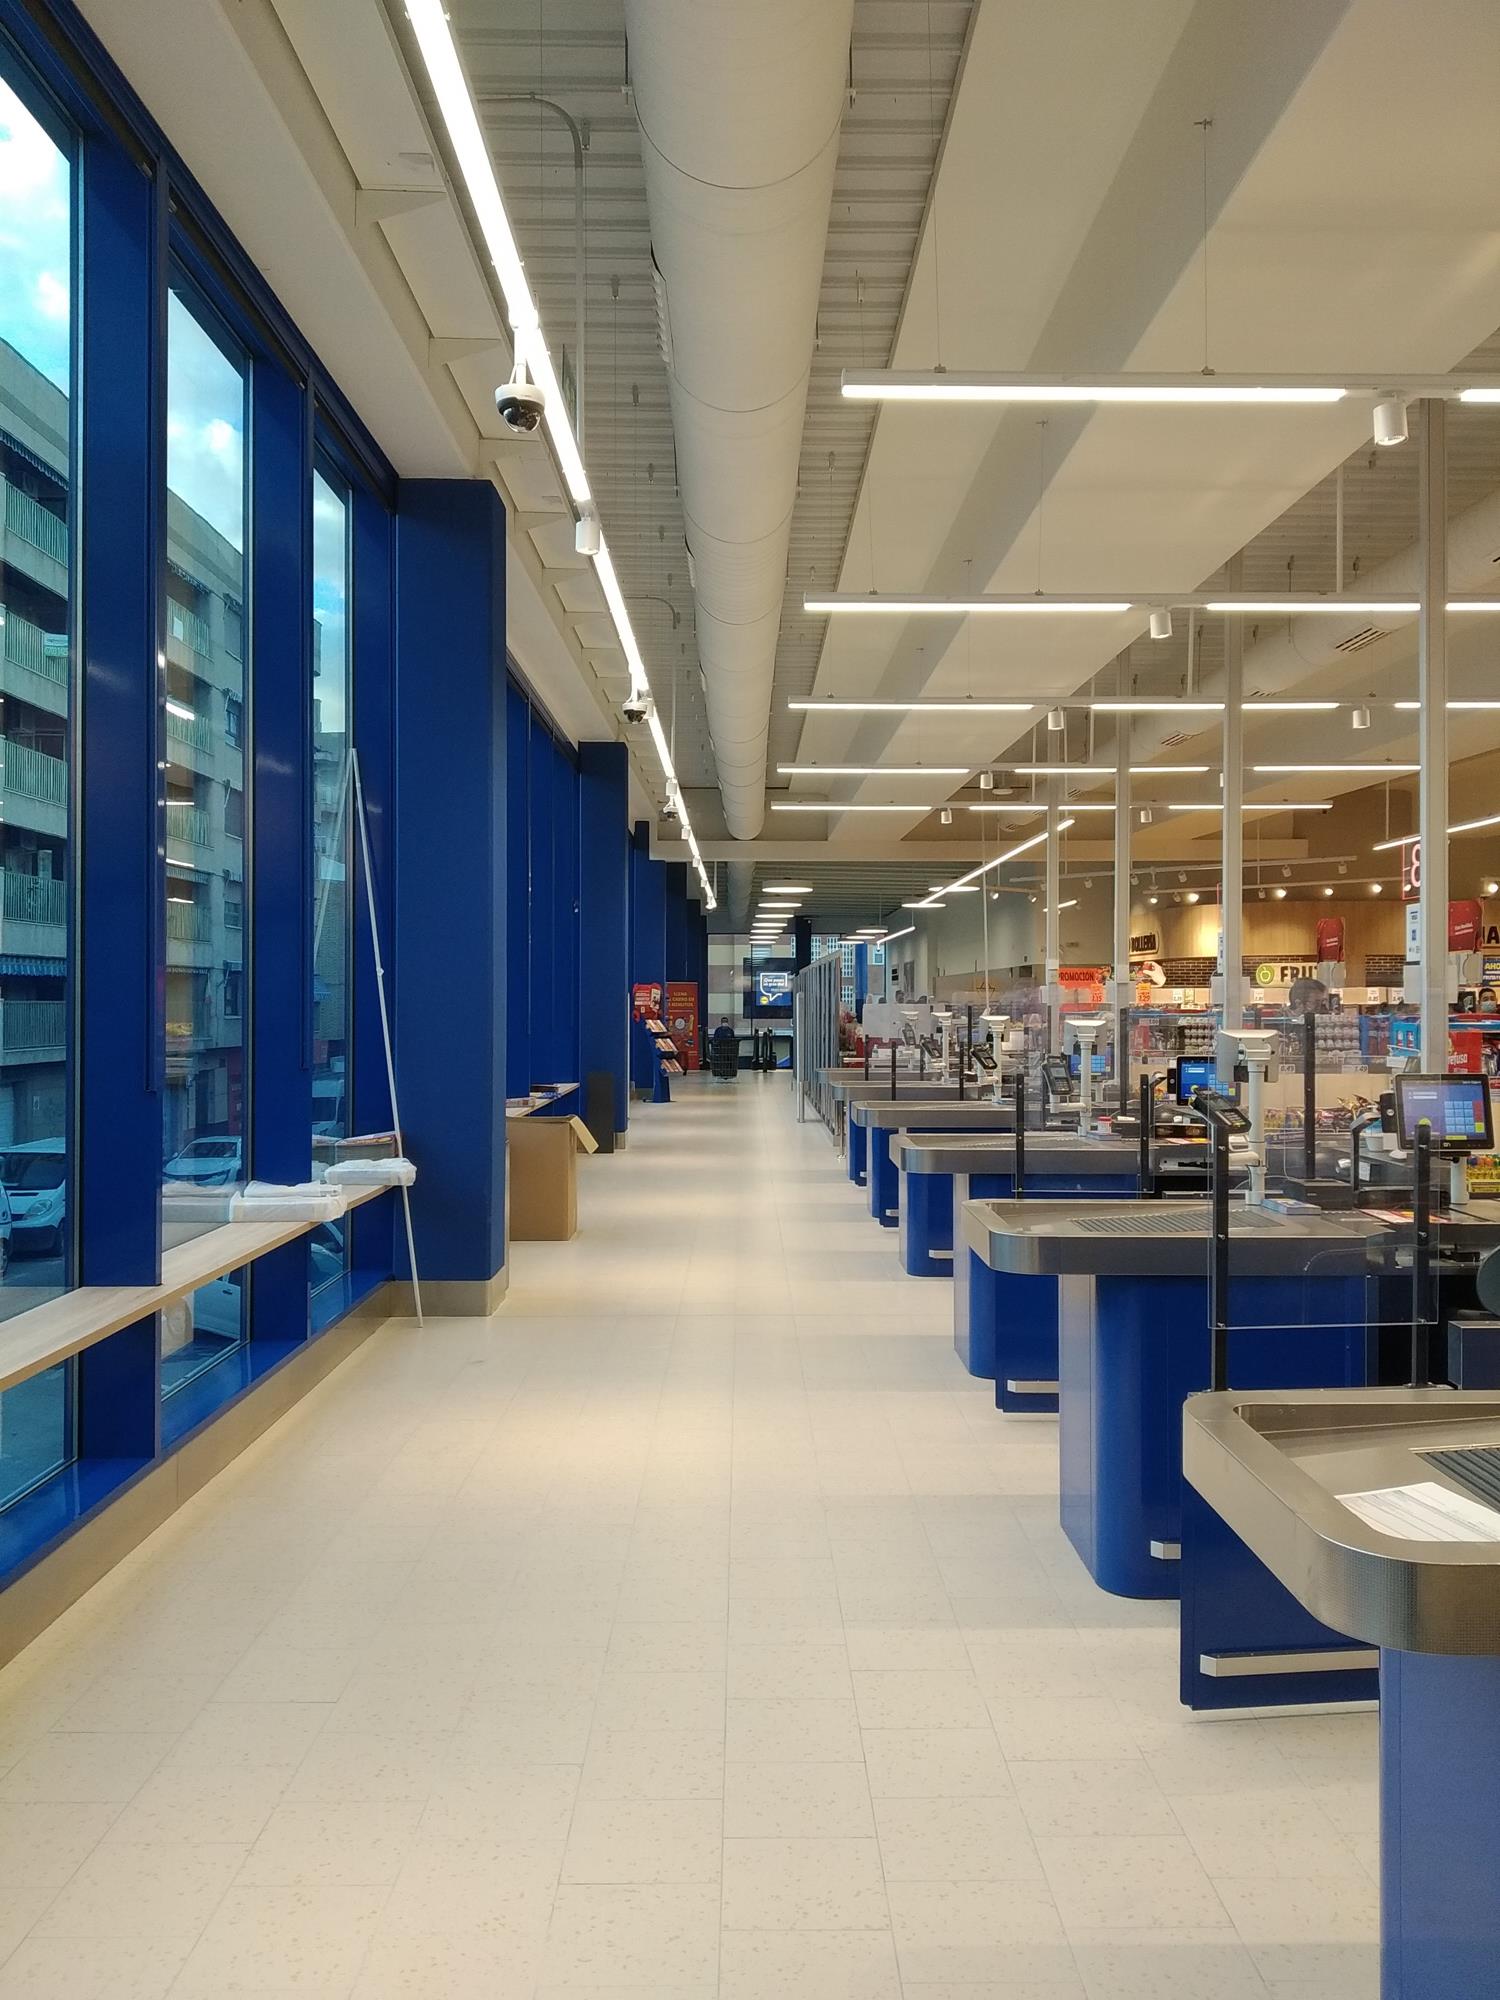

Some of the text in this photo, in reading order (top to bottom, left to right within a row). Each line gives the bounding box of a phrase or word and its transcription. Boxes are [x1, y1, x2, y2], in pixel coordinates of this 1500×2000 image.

[1059, 972, 1094, 982] ROMOCION
[1280, 965, 1318, 983] FRU
[1448, 1052, 1468, 1066] refusa
